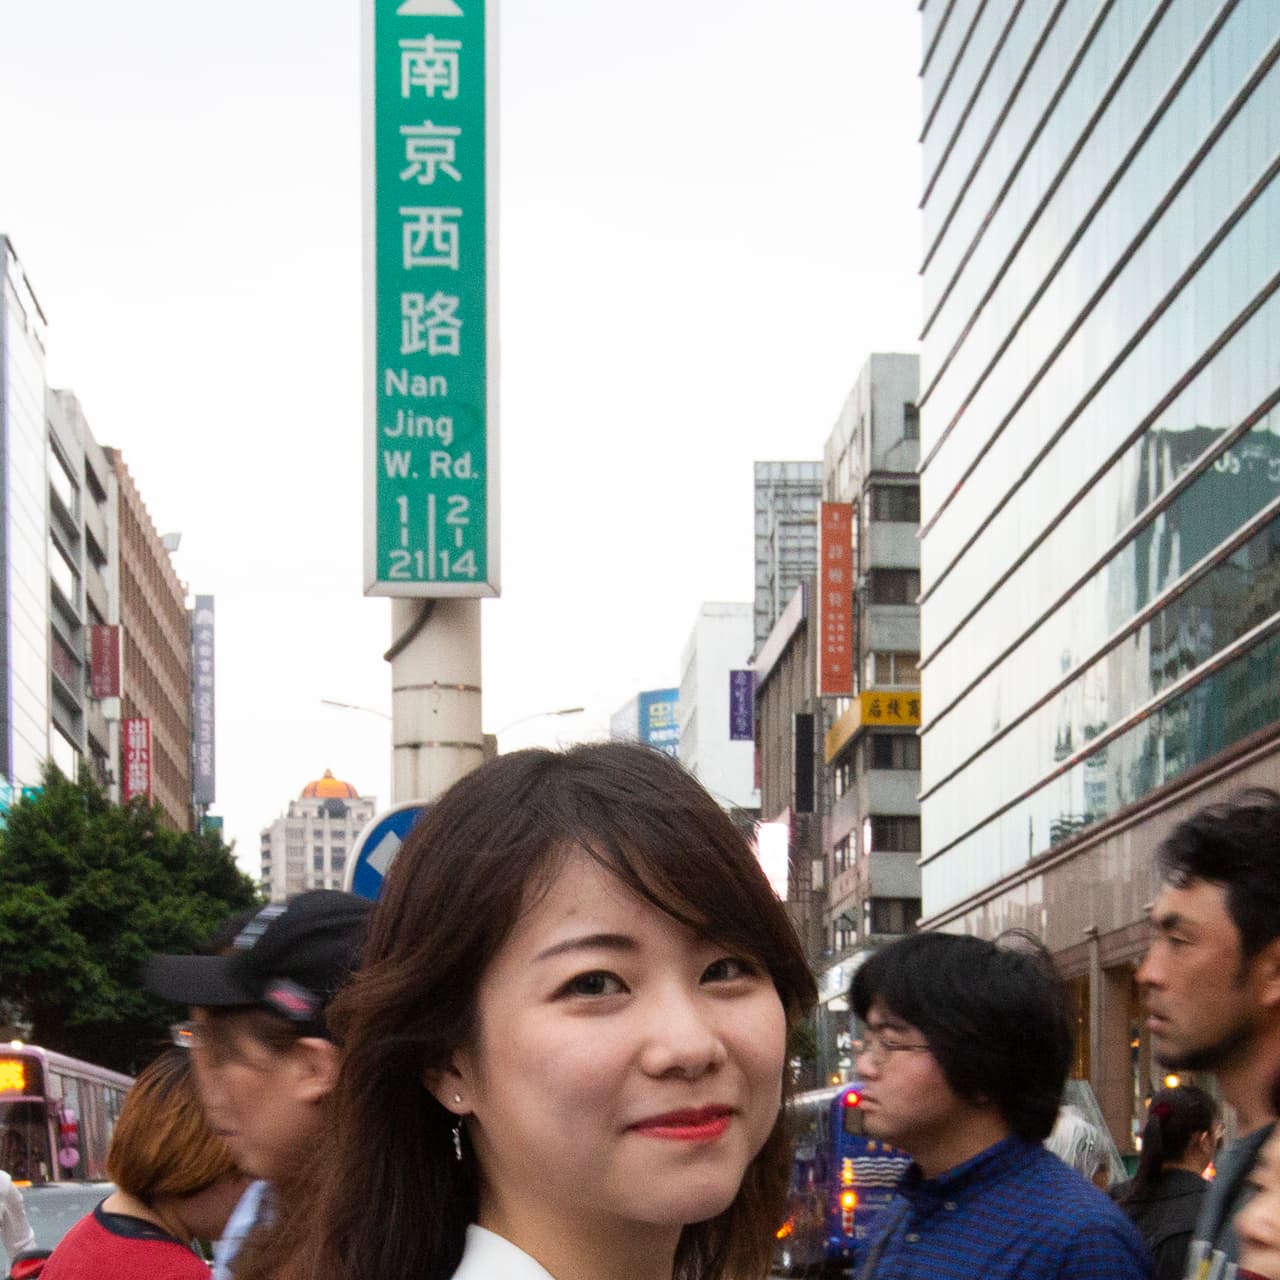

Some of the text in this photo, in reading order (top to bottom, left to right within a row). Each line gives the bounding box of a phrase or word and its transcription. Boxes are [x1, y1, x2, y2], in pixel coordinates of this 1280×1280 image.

[399, 34, 463, 356] 南京西路
[386, 369, 447, 397] Nan
[384, 409, 453, 446] Jing
[384, 451, 479, 478] W. Rd.
